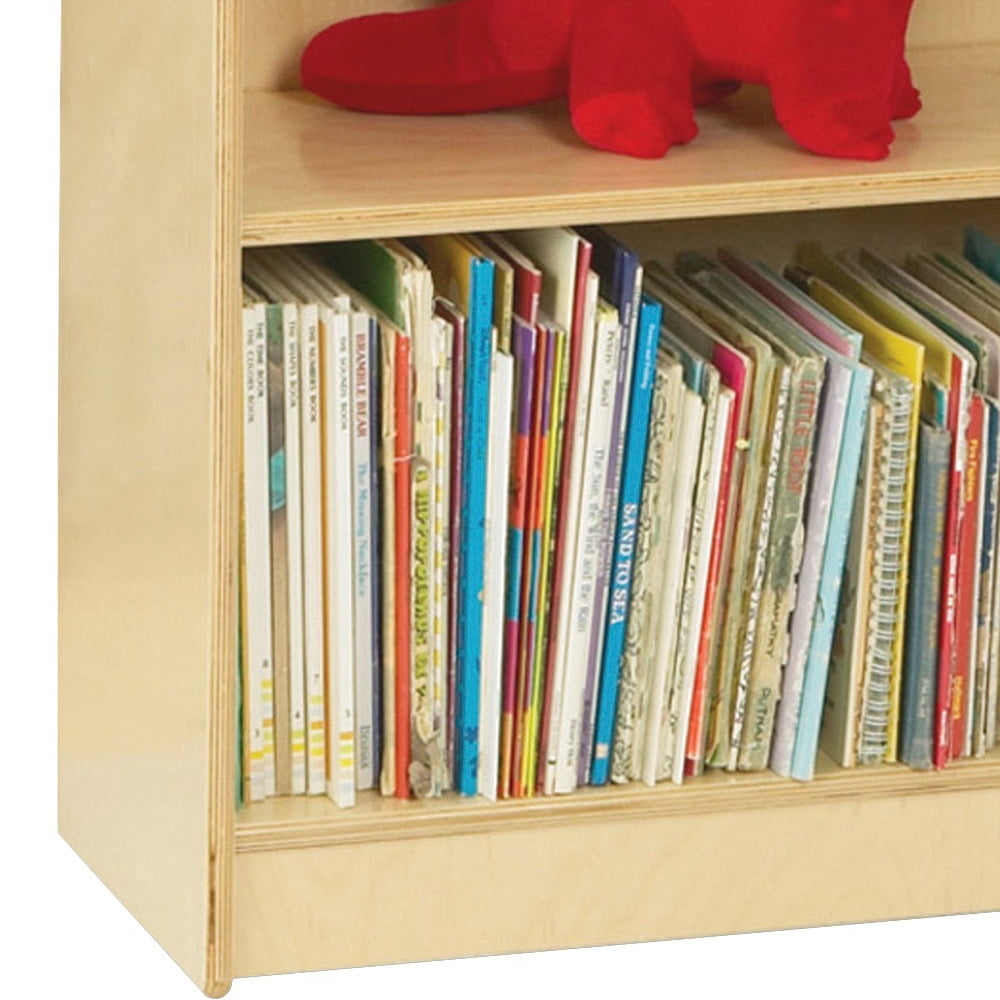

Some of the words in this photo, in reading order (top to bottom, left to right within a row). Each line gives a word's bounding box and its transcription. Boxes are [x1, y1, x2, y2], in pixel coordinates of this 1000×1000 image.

[355, 333, 367, 399] BRAMBLE
[355, 401, 368, 438] BEAR
[794, 379, 817, 437] LITTLE
[593, 448, 605, 471] The
[968, 439, 979, 460] Fire
[788, 446, 811, 497] TOOT
[619, 502, 638, 556] SAND
[582, 557, 593, 581] and
[616, 560, 632, 586] TO
[610, 588, 628, 625] SEA
